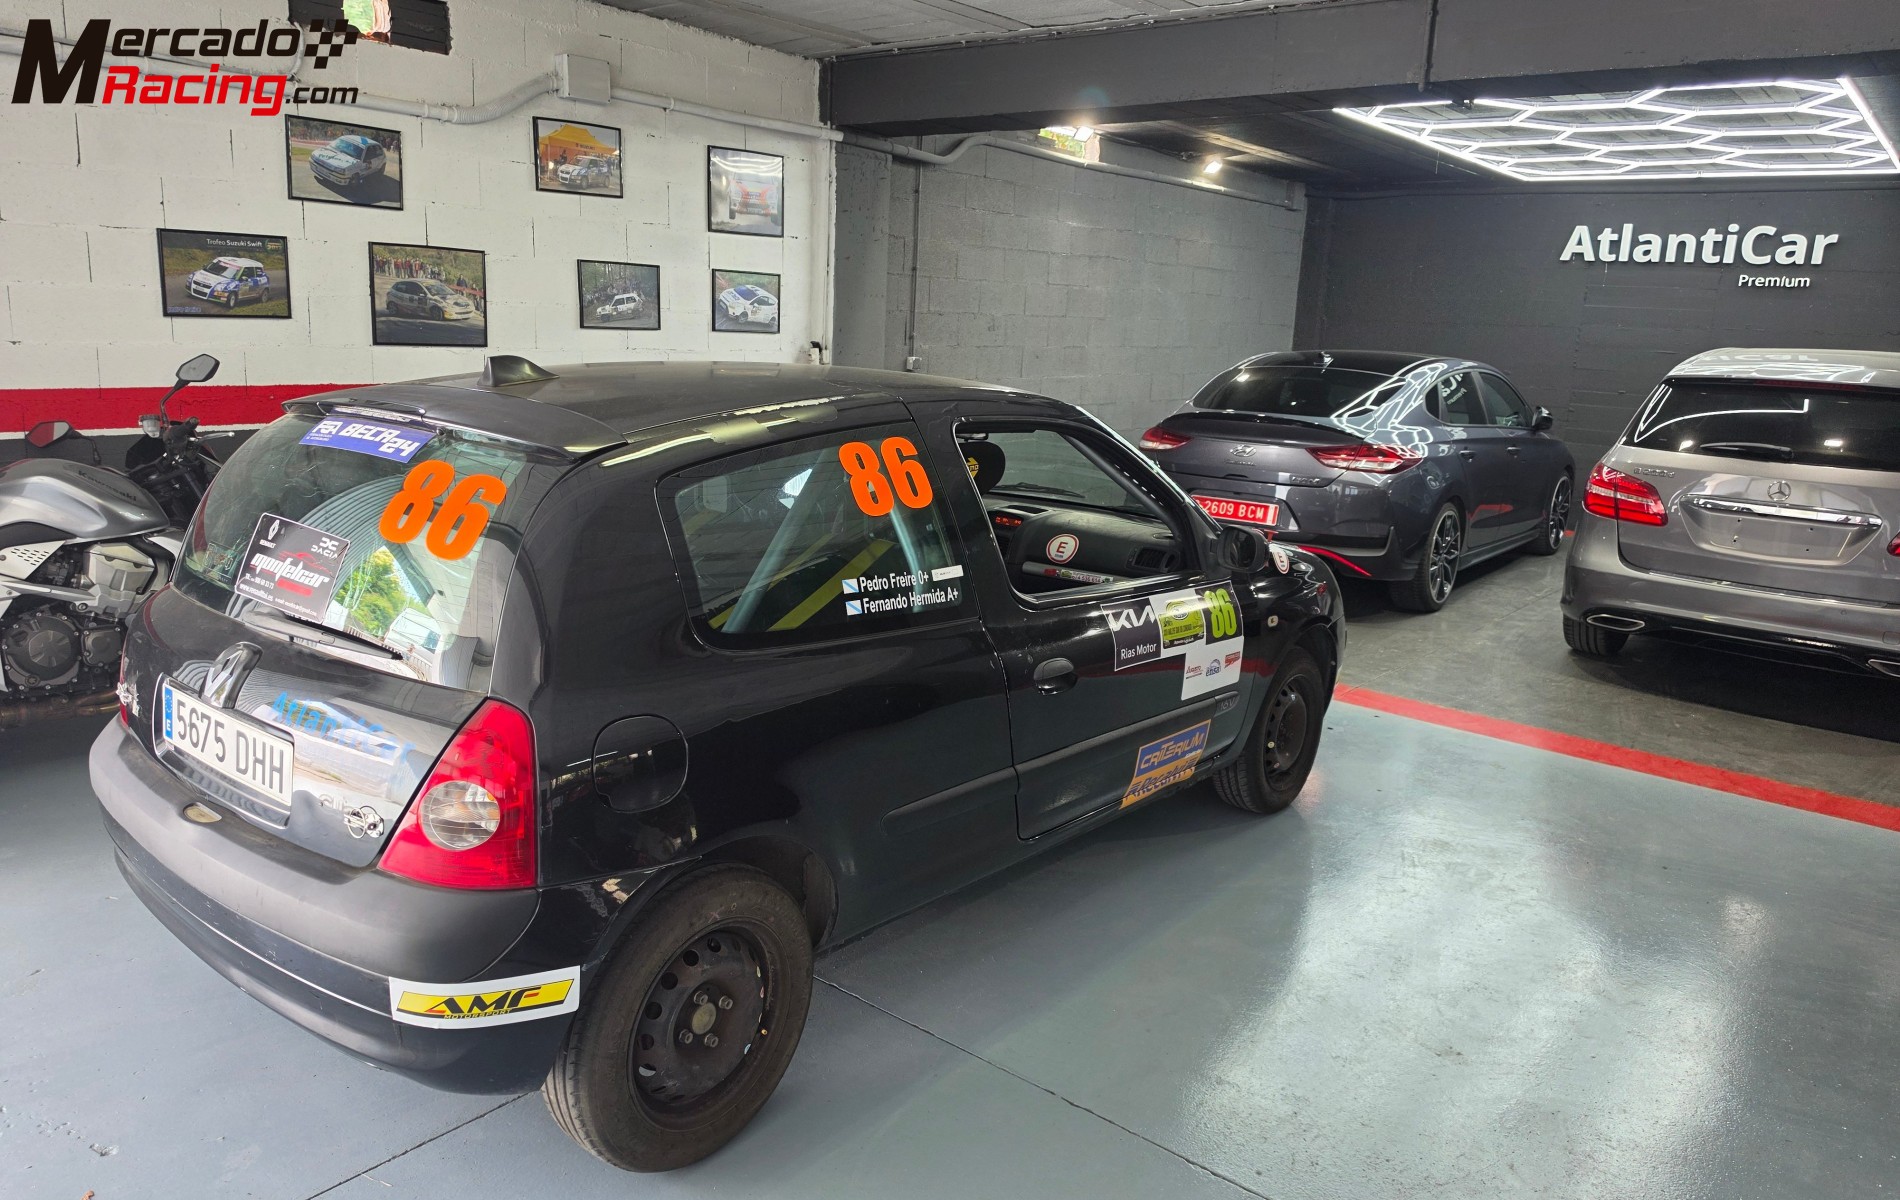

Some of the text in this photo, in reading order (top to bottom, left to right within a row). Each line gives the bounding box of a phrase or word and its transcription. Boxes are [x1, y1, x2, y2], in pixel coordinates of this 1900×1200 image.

[206, 238, 263, 248] Trofeo Suzuki Swift
[1559, 223, 1839, 265] AtlantiCar
[1738, 274, 1811, 288] Premium
[339, 423, 402, 443] BECA
[378, 438, 421, 457] 24
[78, 470, 137, 502] Kawasaki
[838, 436, 934, 517] 86
[378, 459, 507, 561] 86
[1205, 500, 1235, 516] 2609
[1237, 504, 1265, 520] BCM
[310, 544, 339, 559] DACIA
[1055, 541, 1069, 555] E
[859, 574, 889, 593] Pedro
[889, 571, 917, 589] Freire
[863, 586, 959, 614] Fernando Hermida A+
[1204, 588, 1238, 639] 86
[1120, 643, 1157, 660] Rias Motor
[165, 720, 172, 733] E
[176, 701, 285, 794] 5675 DHH
[1140, 732, 1205, 769] CRITERIUM
[424, 986, 541, 1014] AMF
[443, 1009, 514, 1020] MOTORSPORT
